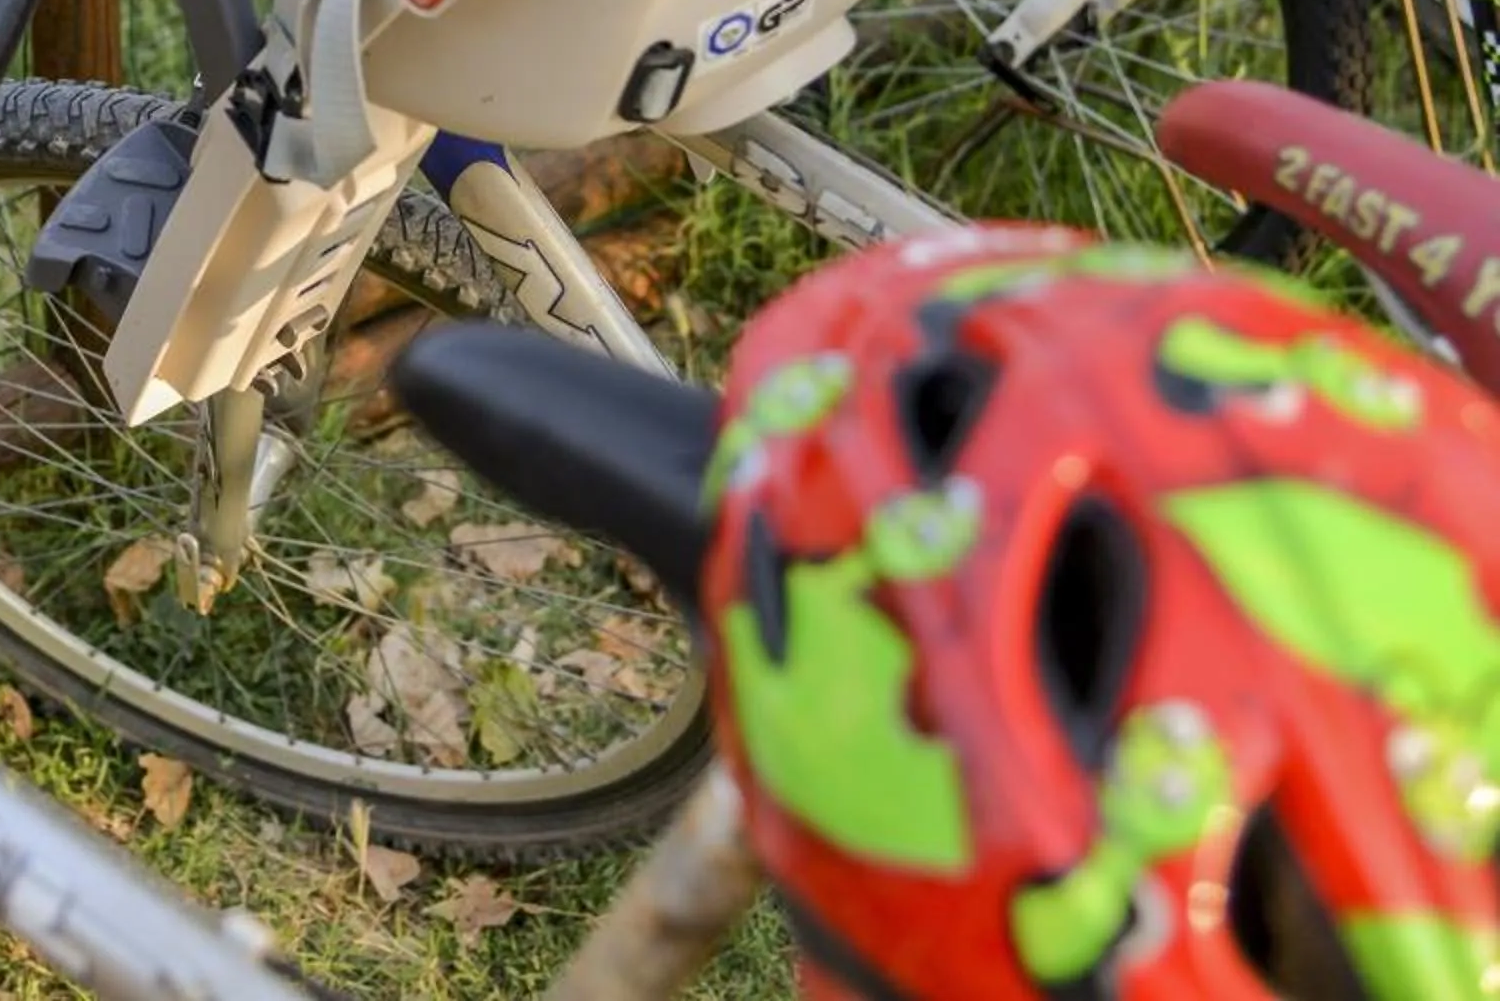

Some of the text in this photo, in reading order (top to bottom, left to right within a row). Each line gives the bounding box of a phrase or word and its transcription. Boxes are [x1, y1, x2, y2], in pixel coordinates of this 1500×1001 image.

[1274, 145, 1311, 192] 2
[1303, 162, 1421, 254] FAST
[1408, 234, 1465, 289] 4
